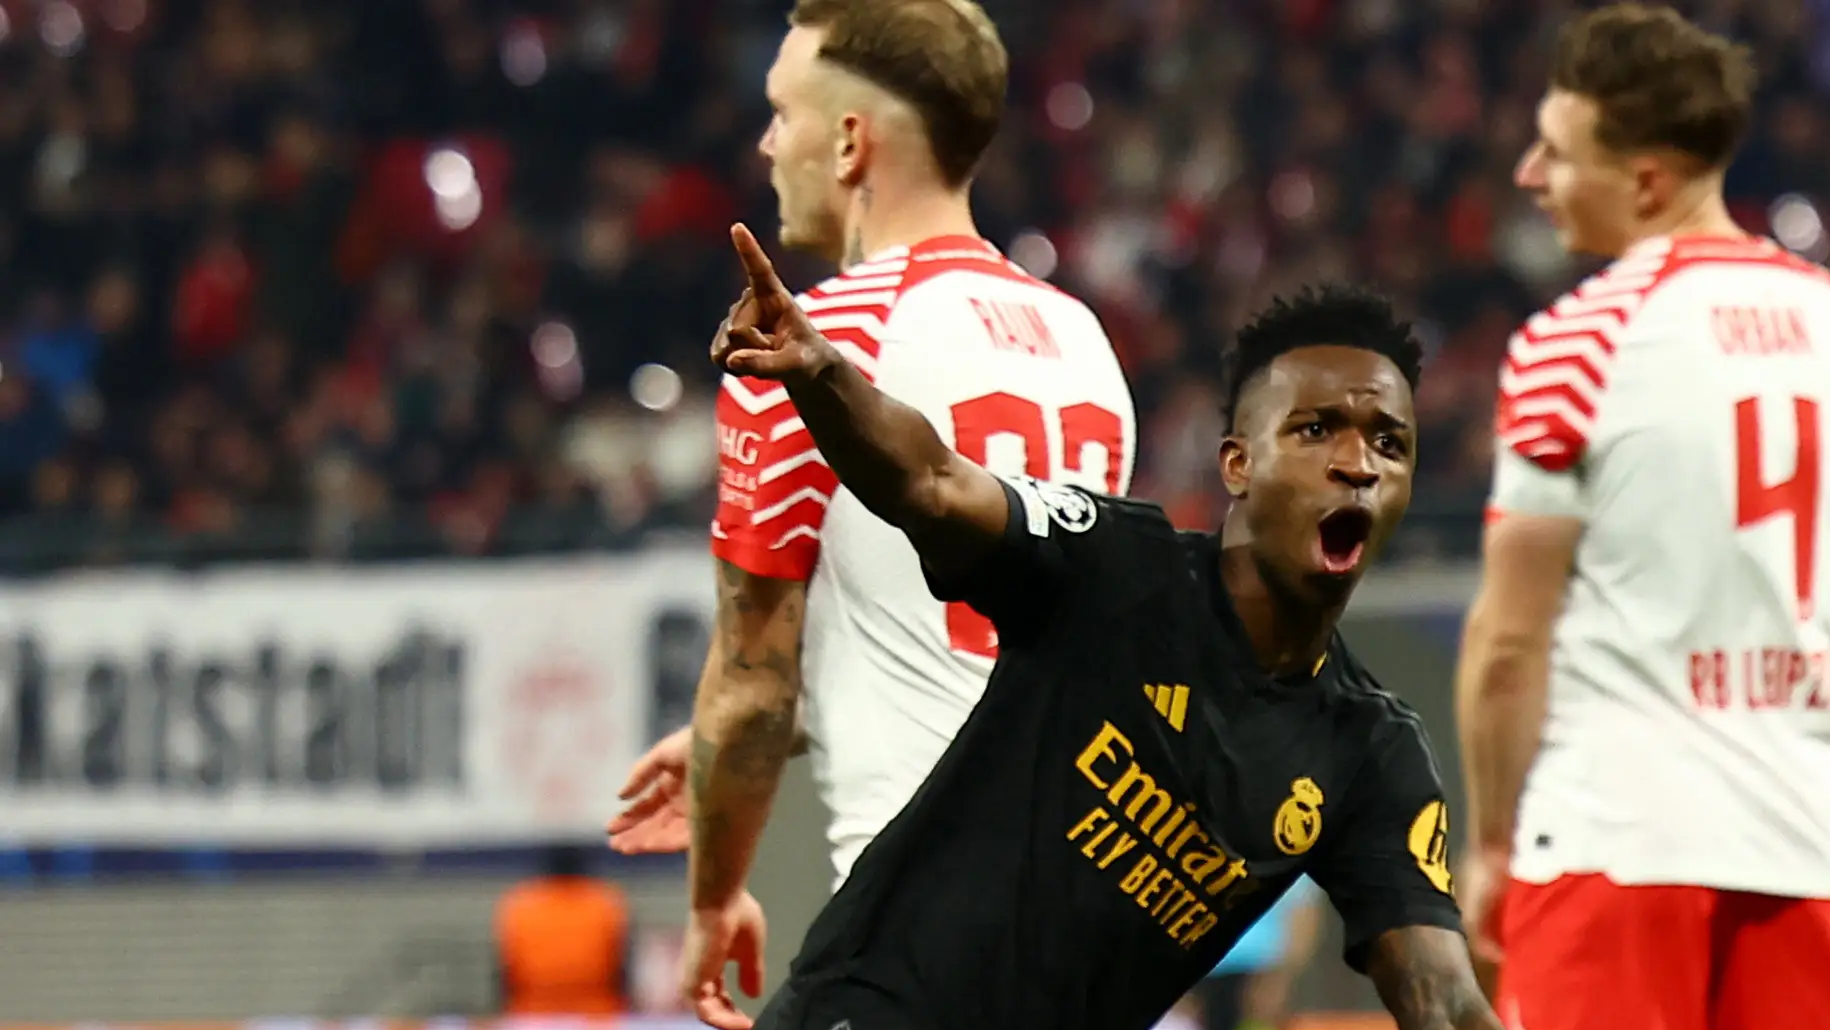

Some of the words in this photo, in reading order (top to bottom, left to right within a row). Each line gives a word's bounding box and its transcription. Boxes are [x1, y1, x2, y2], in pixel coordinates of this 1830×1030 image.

[1734, 396, 1818, 620] 4
[1687, 650, 1730, 710] RB
[1065, 806, 1138, 870] FLY
[1118, 853, 1219, 950] BETTER
[1075, 719, 1248, 896] Emirat
